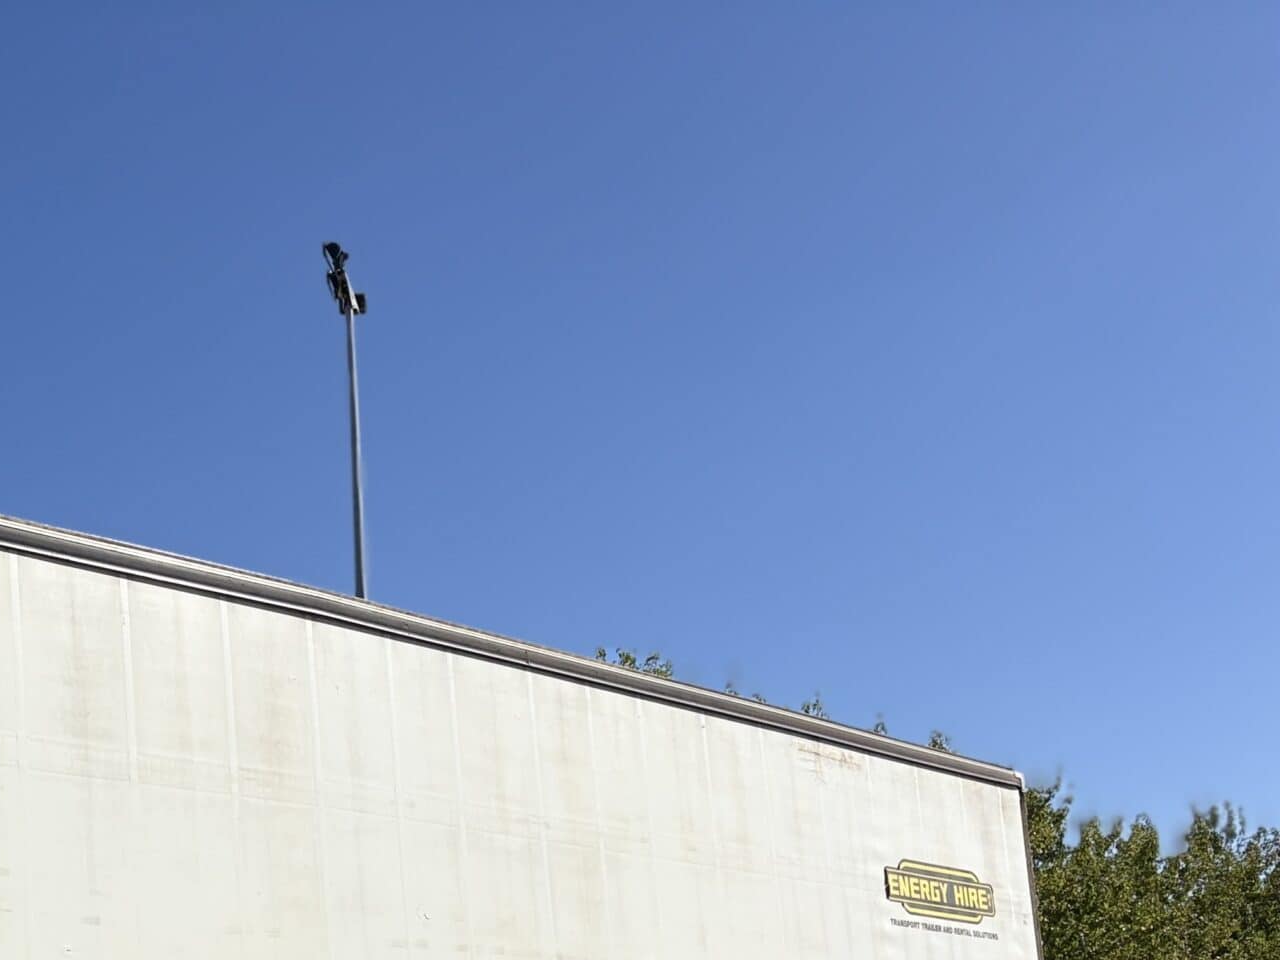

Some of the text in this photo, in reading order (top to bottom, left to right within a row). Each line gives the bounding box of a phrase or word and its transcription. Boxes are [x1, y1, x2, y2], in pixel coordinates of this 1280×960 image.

[888, 873, 990, 911] ENERGY HIRE
[890, 918, 999, 940] TRANSPORT TRAILER AND RENTAL SOLUTIONS
